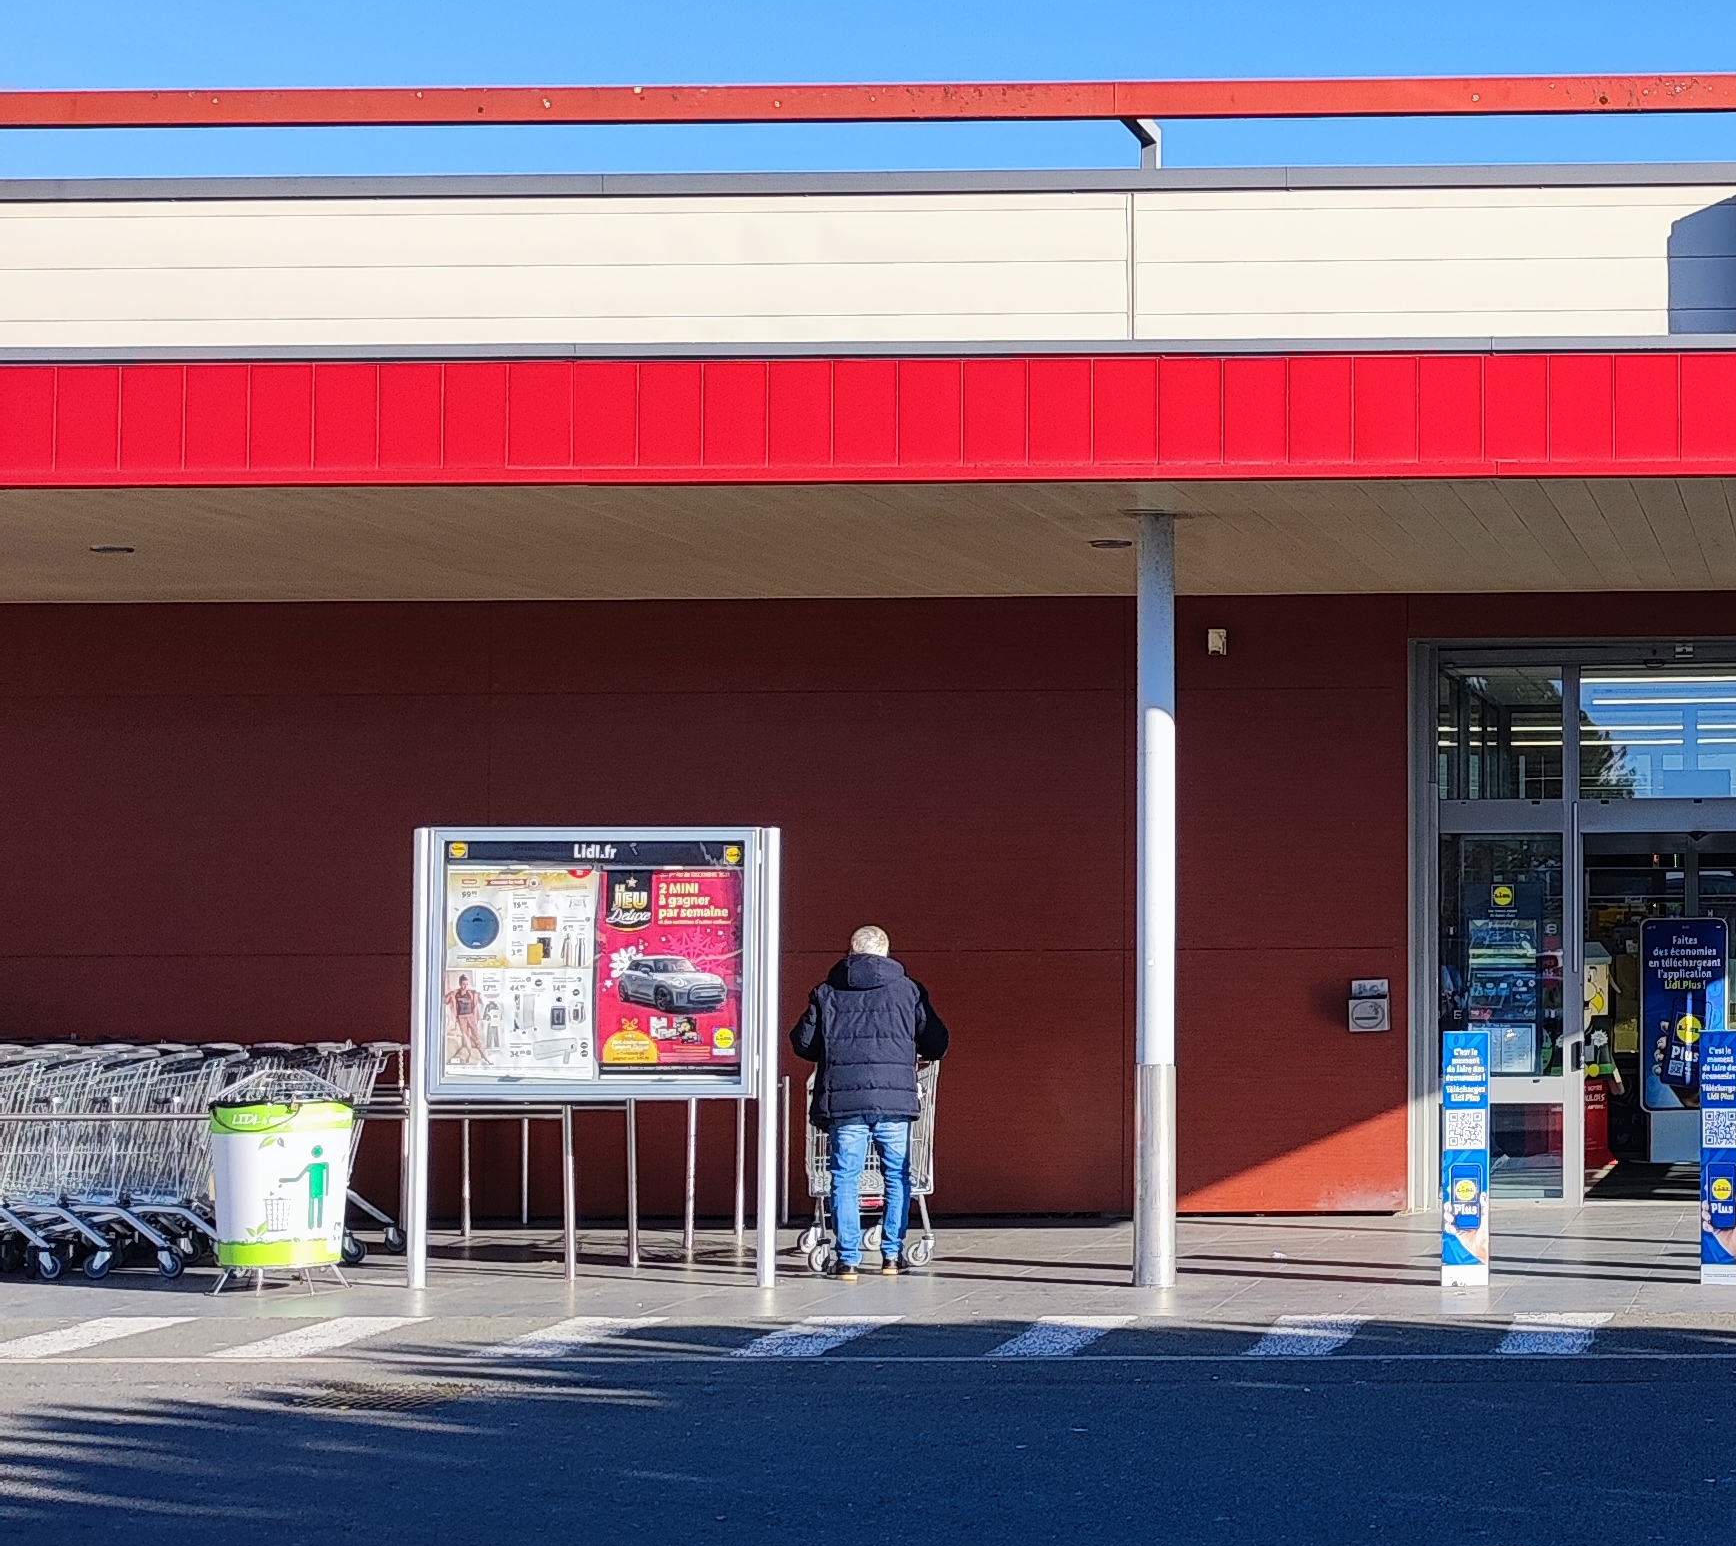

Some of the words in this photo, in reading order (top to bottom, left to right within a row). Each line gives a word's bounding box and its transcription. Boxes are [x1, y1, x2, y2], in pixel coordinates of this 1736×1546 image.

[573, 843, 617, 859] Lidl.fr
[659, 883, 667, 894] 2
[669, 883, 699, 894] MINI
[611, 892, 648, 910] JEU
[659, 894, 666, 905] à
[668, 897, 710, 908] gagner
[659, 909, 679, 919] par
[680, 906, 729, 917] semaine
[1672, 936, 1698, 945] Faites
[1653, 946, 1668, 956] des
[1670, 945, 1717, 956] économies
[1649, 959, 1659, 967] en
[1661, 958, 1721, 971] téléchargeant
[1658, 968, 1712, 980] l'application
[1664, 980, 1681, 990] Lidl
[1683, 980, 1701, 990] Plus
[1671, 1045, 1700, 1063] Plus
[1453, 1204, 1477, 1215] Plus
[1711, 1203, 1733, 1214] Plus
